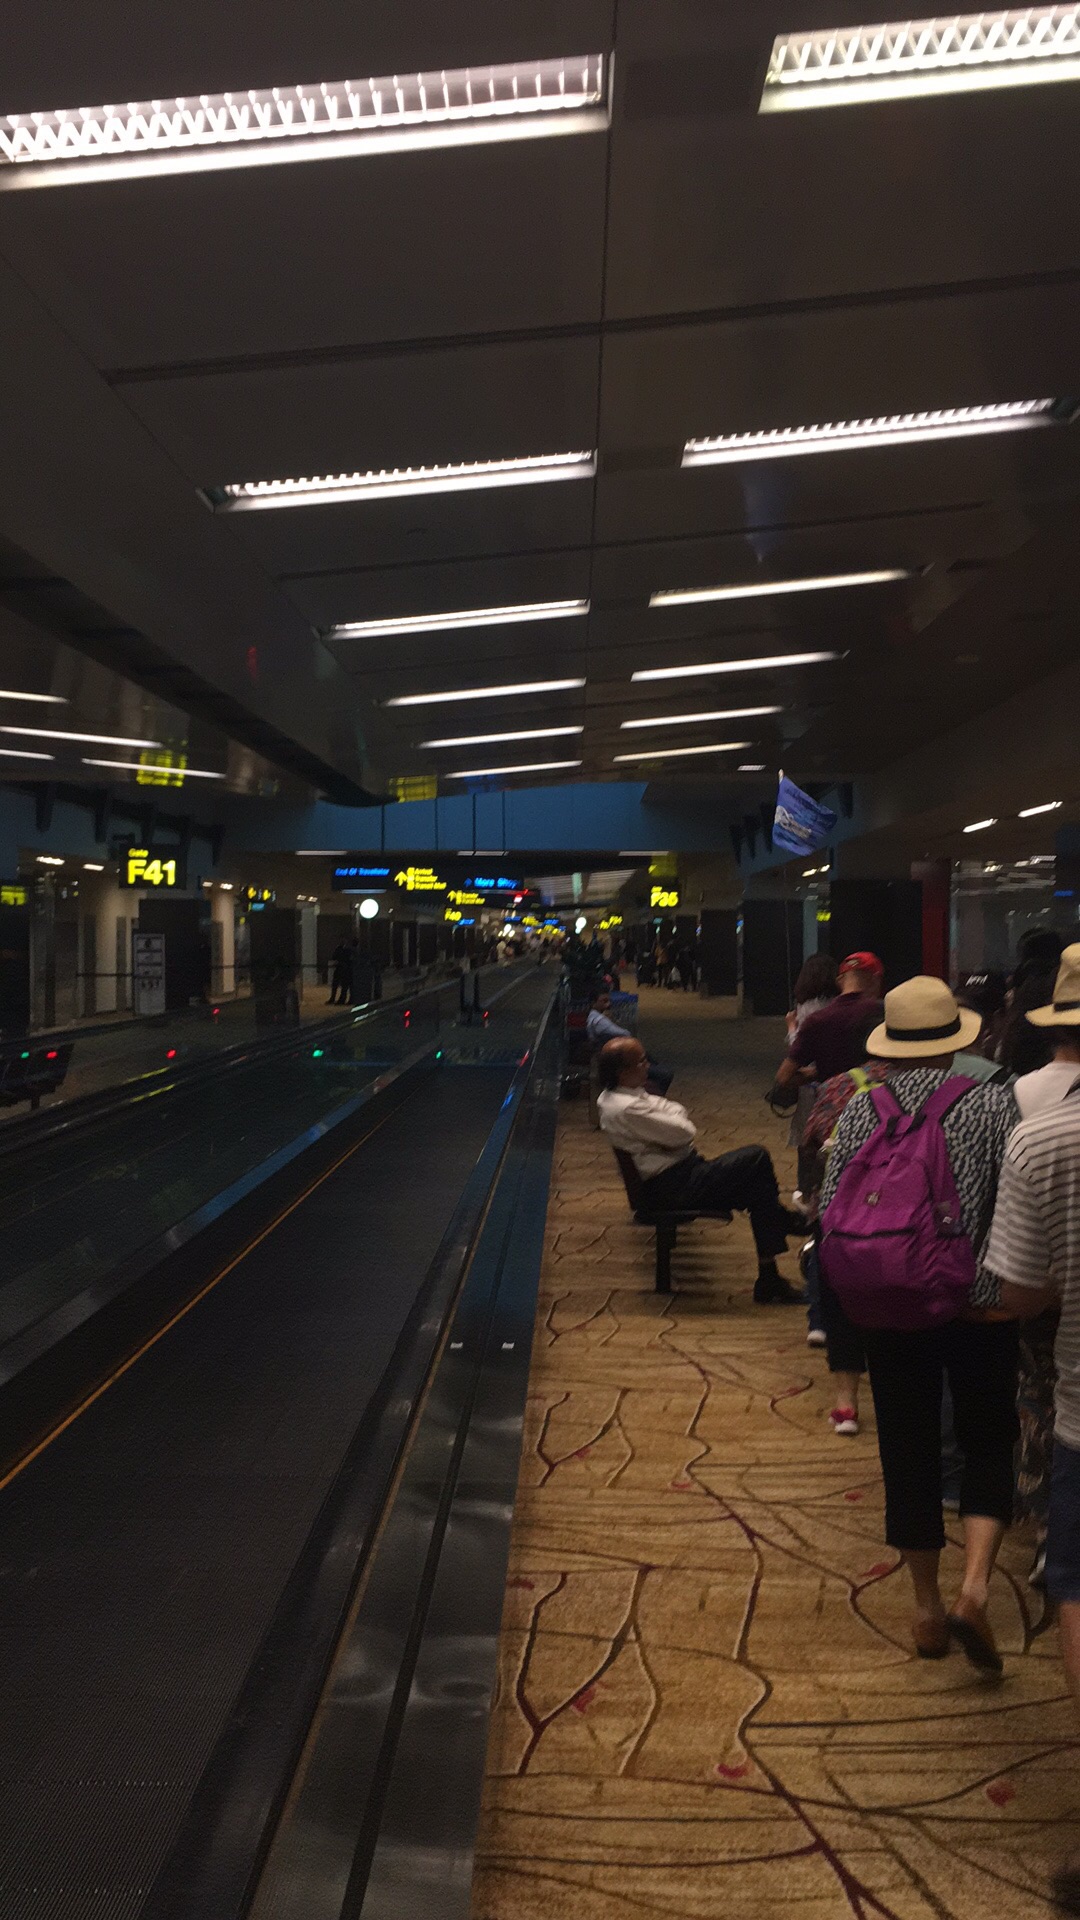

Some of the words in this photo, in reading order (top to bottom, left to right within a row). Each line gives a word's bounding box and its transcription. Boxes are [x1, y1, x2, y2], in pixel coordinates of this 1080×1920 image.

[128, 848, 149, 857] Gate
[128, 859, 176, 885] F41
[474, 878, 495, 887] More
